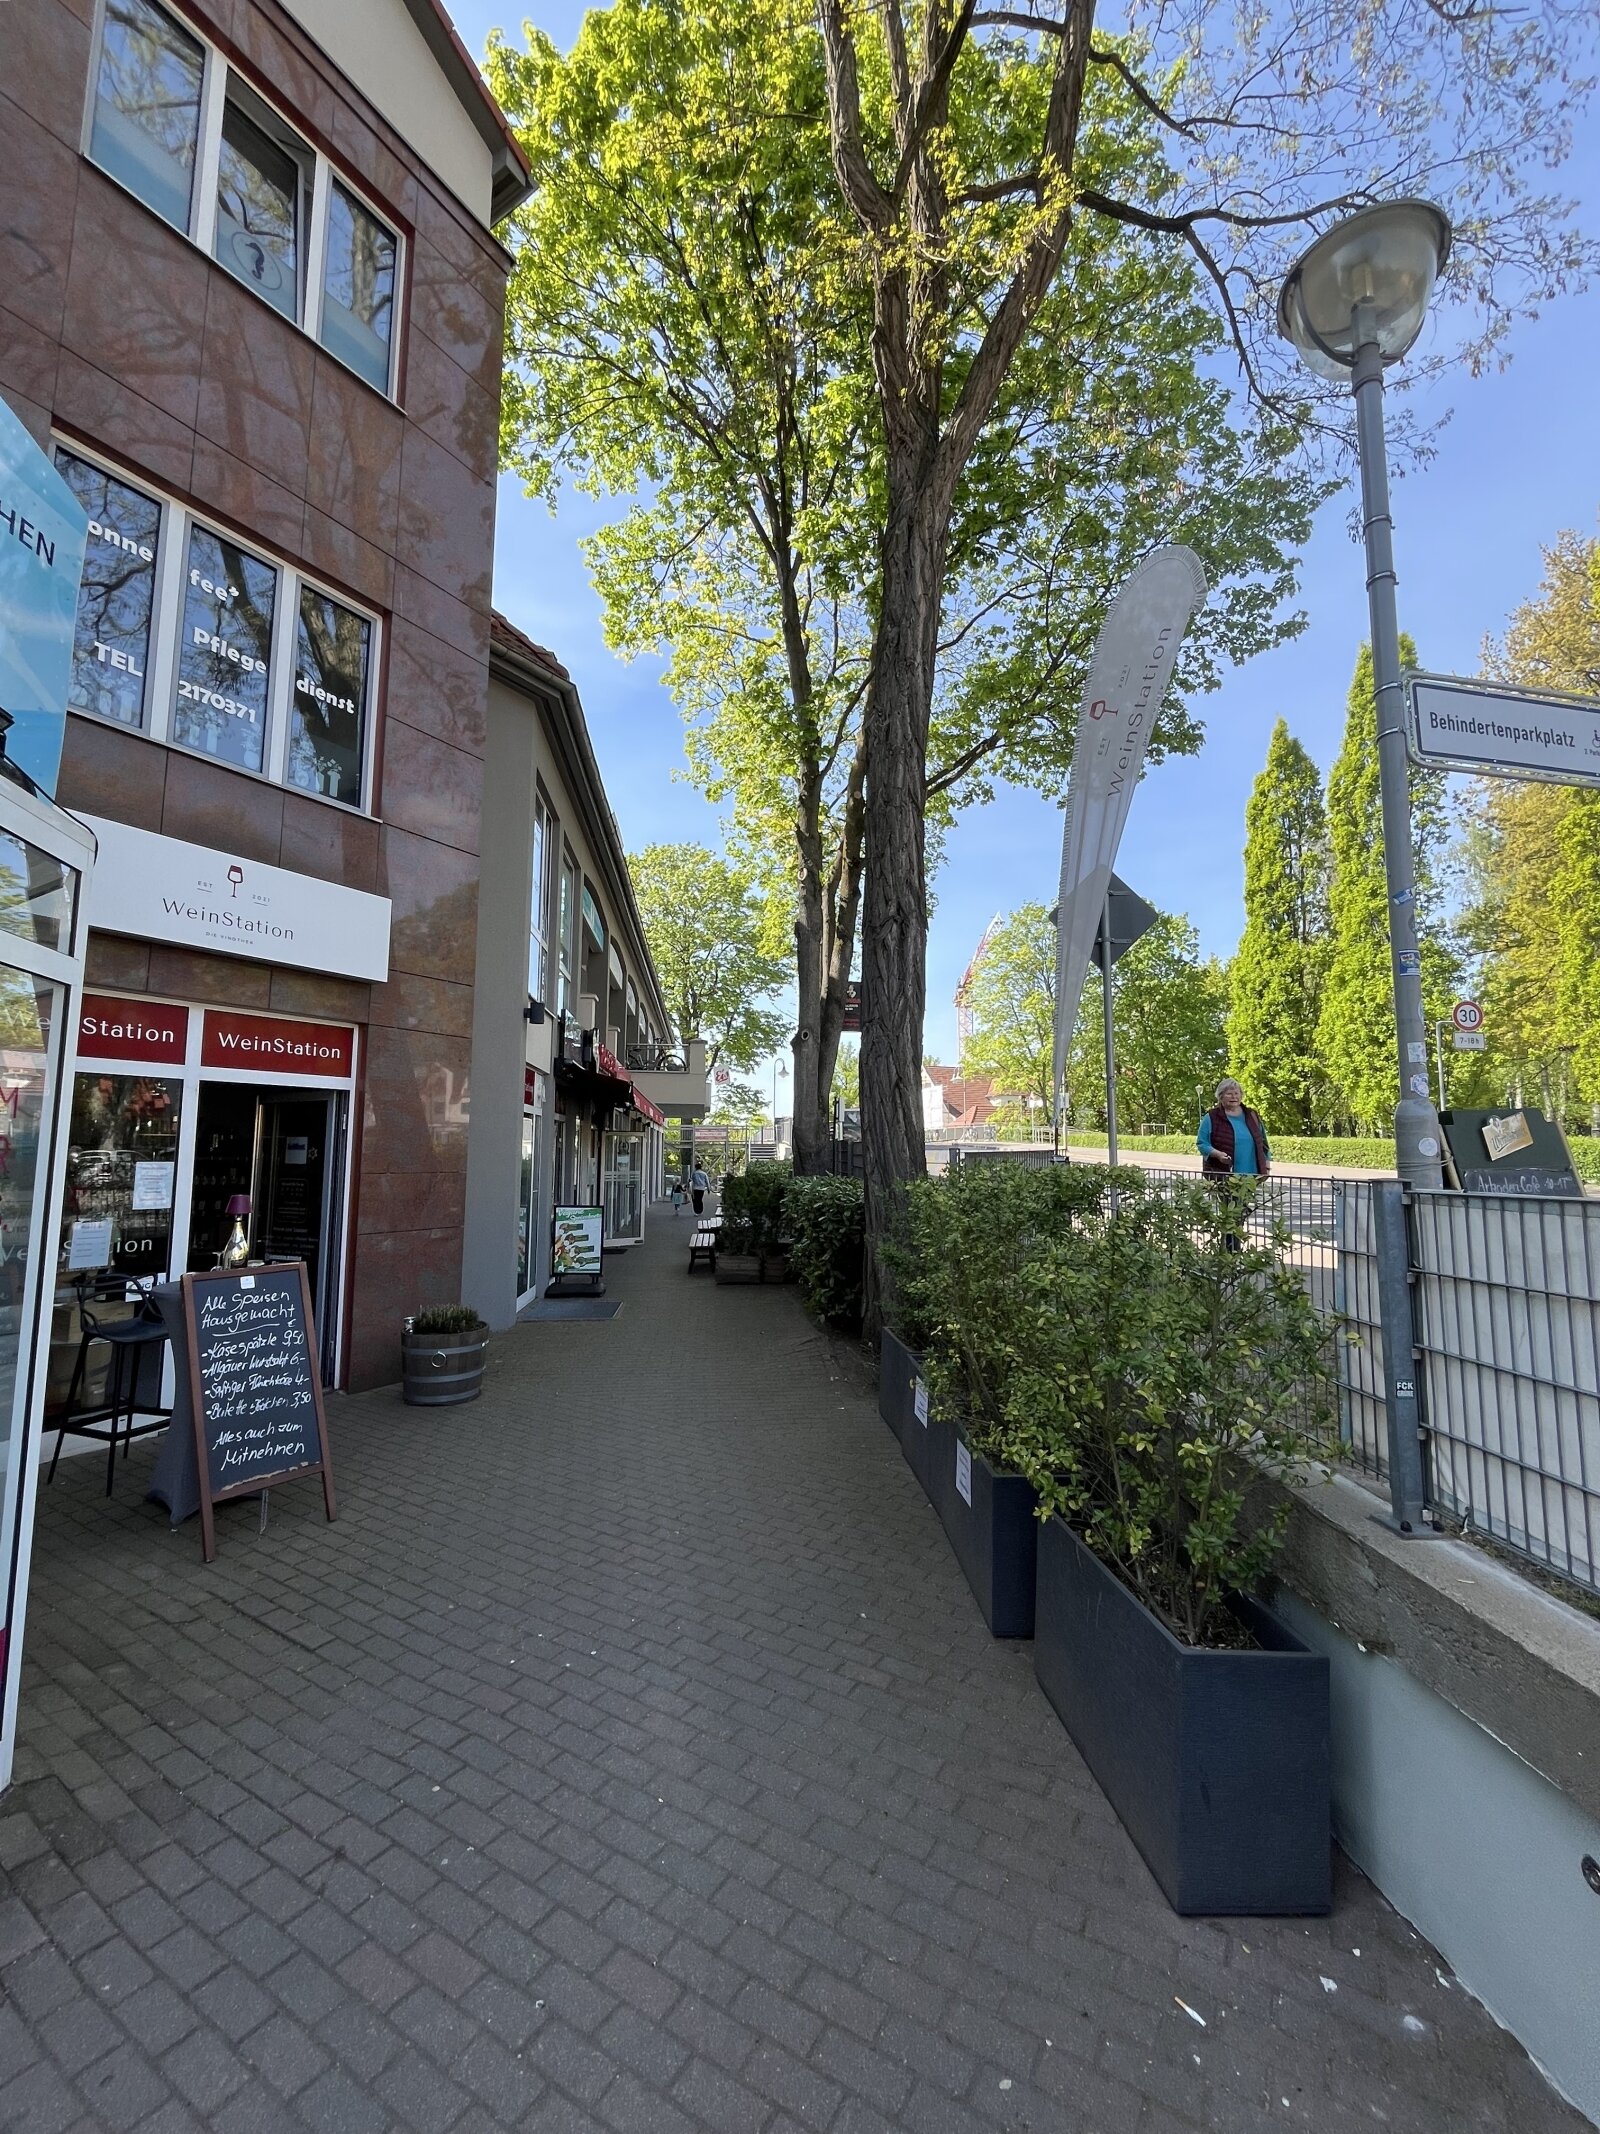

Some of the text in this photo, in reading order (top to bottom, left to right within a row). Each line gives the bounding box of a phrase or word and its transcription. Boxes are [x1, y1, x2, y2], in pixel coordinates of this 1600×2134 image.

[94, 641, 257, 723] TEL 2170371
[296, 678, 355, 714] dienst
[1107, 627, 1172, 797] WeinStation
[1430, 712, 1576, 748] Behindertenparkplatz
[197, 880, 213, 889] EST
[163, 898, 294, 940] WeinStation
[82, 1017, 174, 1043] Station
[1459, 1009, 1477, 1023] 30
[218, 1031, 340, 1059] WeinStation
[201, 1288, 290, 1314] Alle Speisen
[201, 1303, 296, 1332] Hausgemacht
[282, 1330, 304, 1347] 9,50
[1396, 1381, 1414, 1390] FCK
[212, 1422, 303, 1450] Alles auch zum
[220, 1441, 305, 1471] Mitnehmen
